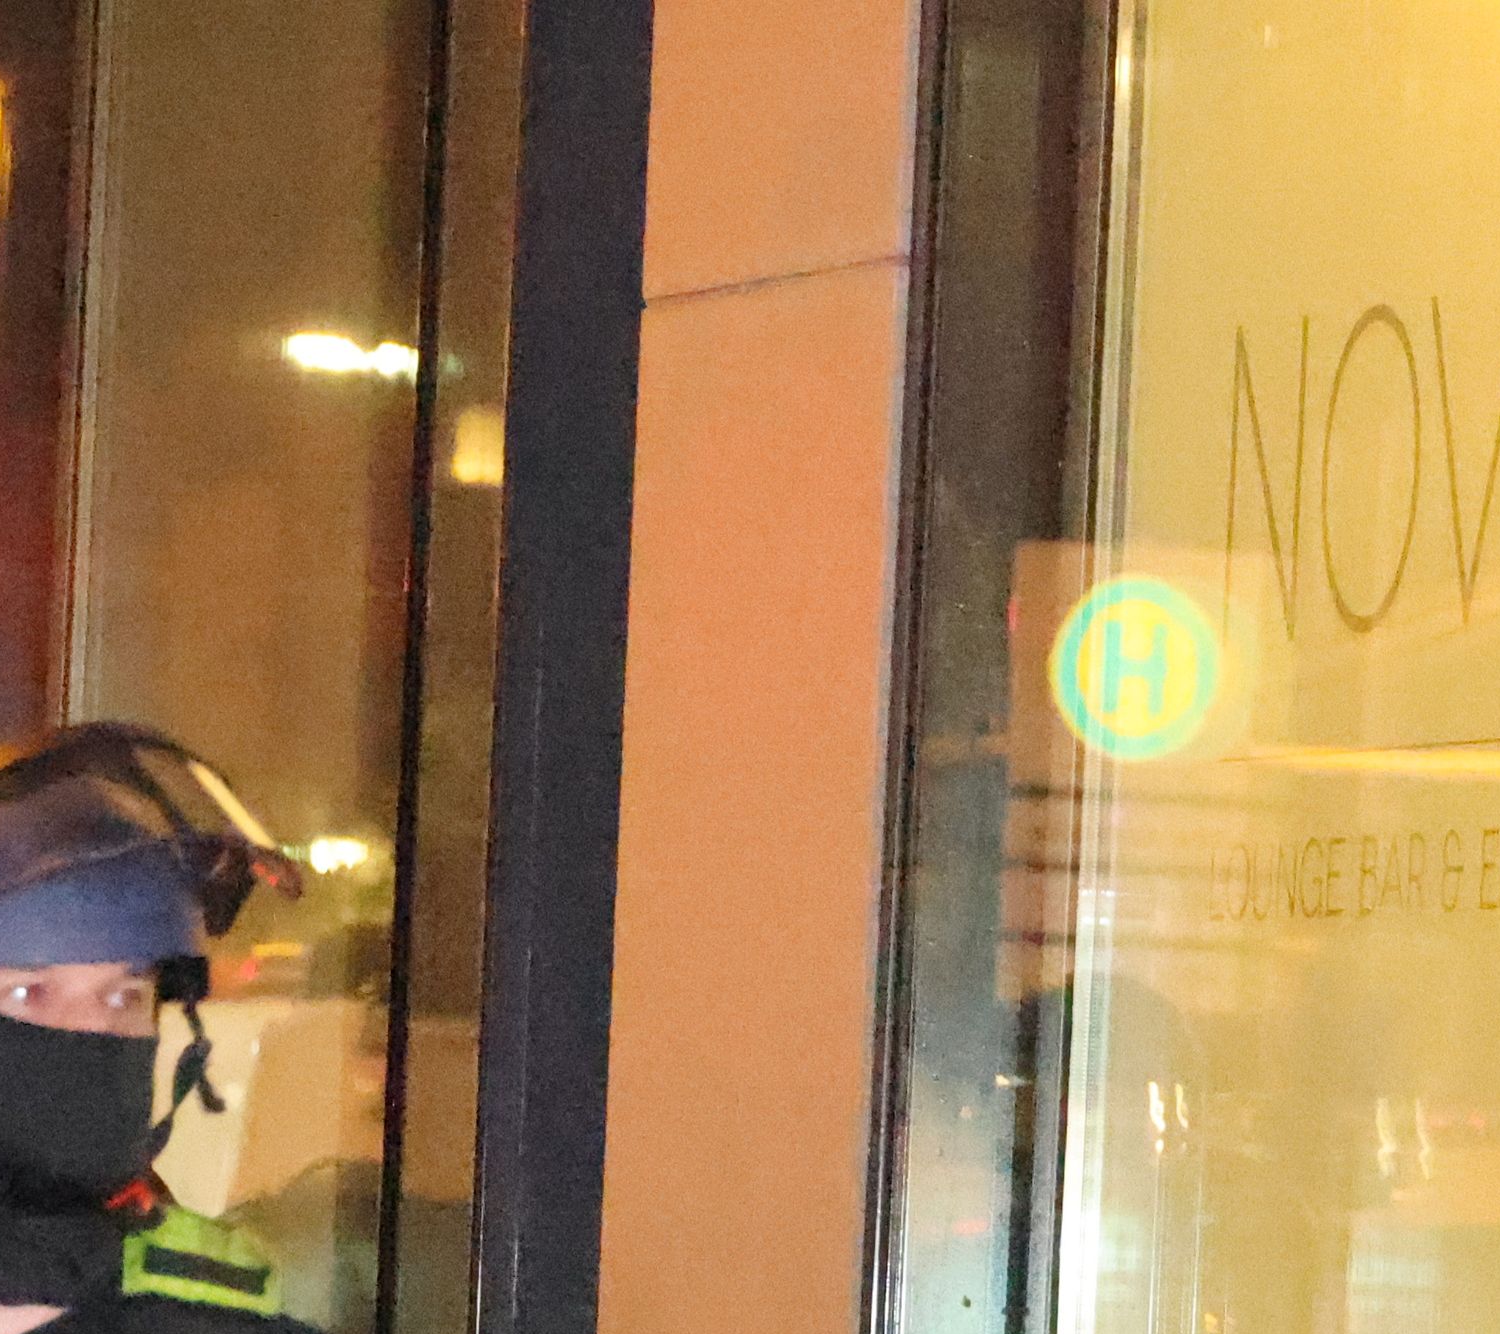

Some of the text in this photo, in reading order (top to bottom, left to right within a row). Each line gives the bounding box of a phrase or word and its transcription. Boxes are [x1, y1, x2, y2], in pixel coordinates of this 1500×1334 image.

[1208, 836, 1347, 922] LOUNGE
[1358, 831, 1427, 920] BAR
[1442, 828, 1465, 913] &
